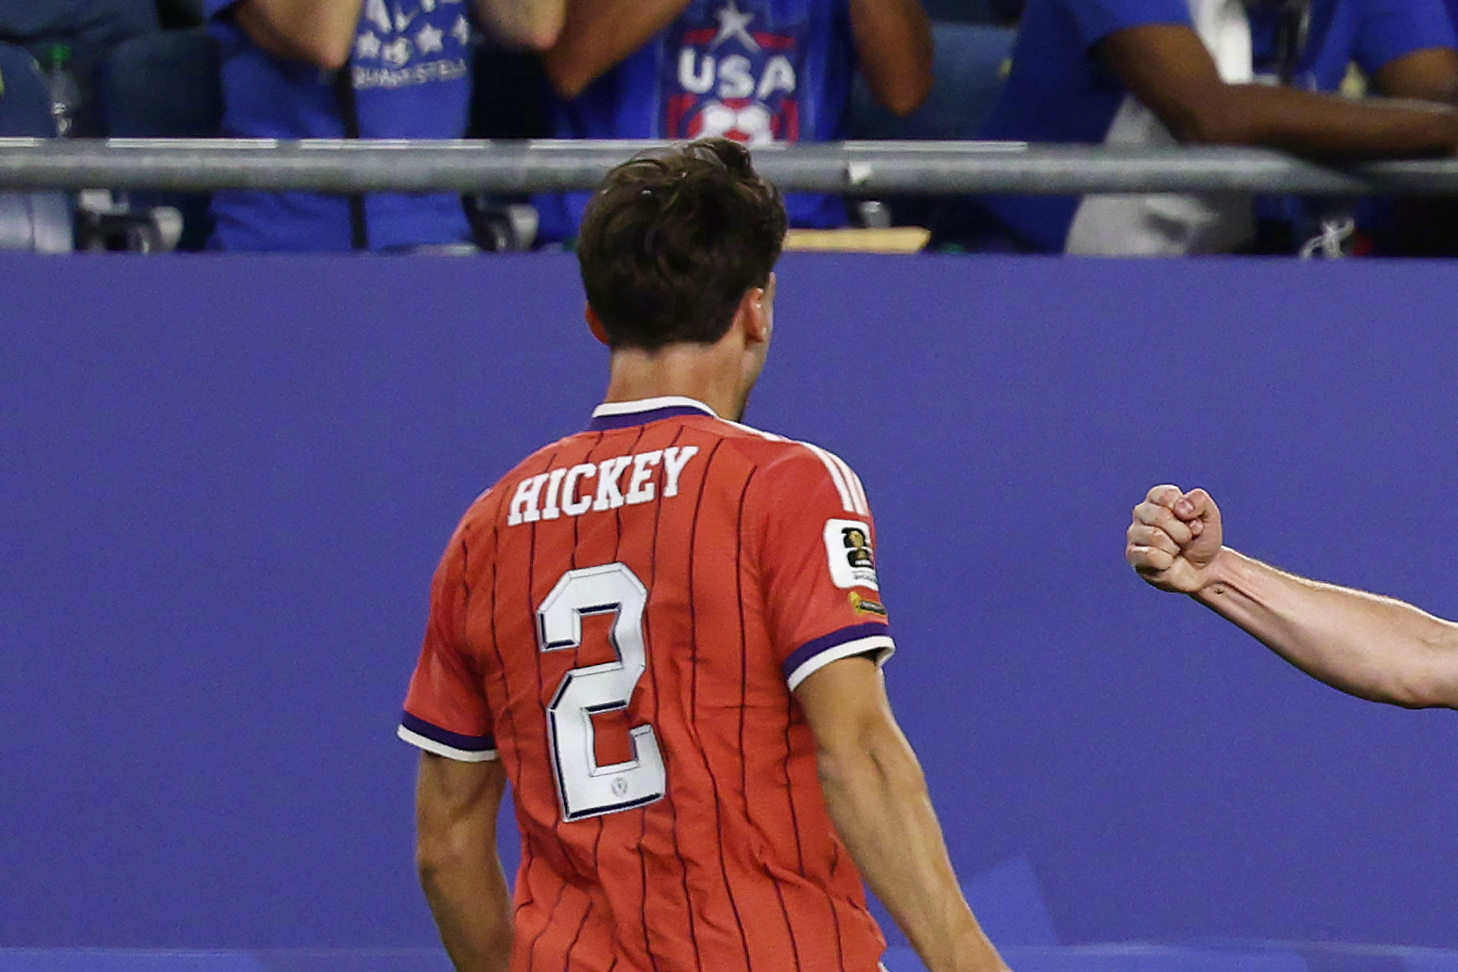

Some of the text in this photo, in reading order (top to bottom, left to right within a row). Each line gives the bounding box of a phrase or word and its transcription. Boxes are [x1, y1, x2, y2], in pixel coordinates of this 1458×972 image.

[677, 47, 797, 100] USA
[507, 446, 699, 526] HICKEY
[537, 561, 666, 822] 2
